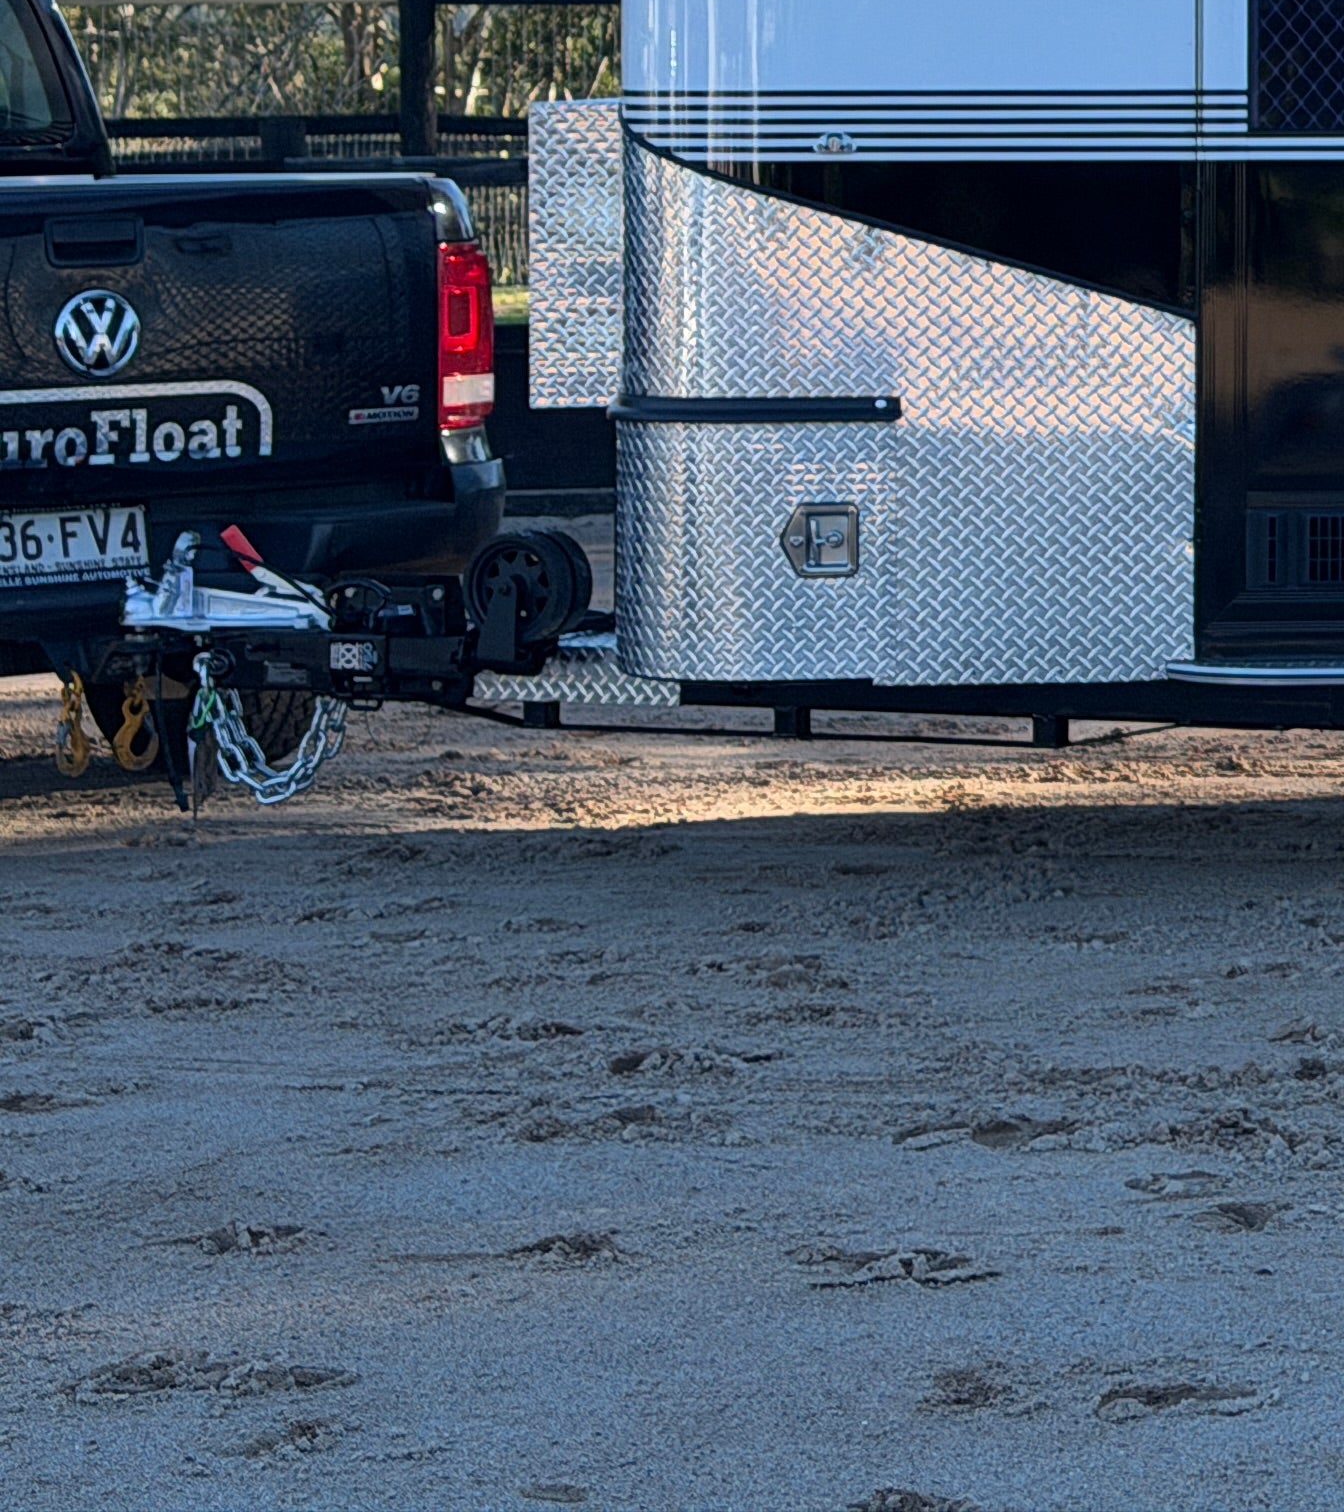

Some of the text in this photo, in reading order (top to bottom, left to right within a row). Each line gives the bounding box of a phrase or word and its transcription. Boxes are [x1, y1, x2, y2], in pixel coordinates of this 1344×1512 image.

[57, 291, 139, 375] VW
[381, 384, 420, 404] V6
[82, 568, 151, 582] AUTOMOTIVE
